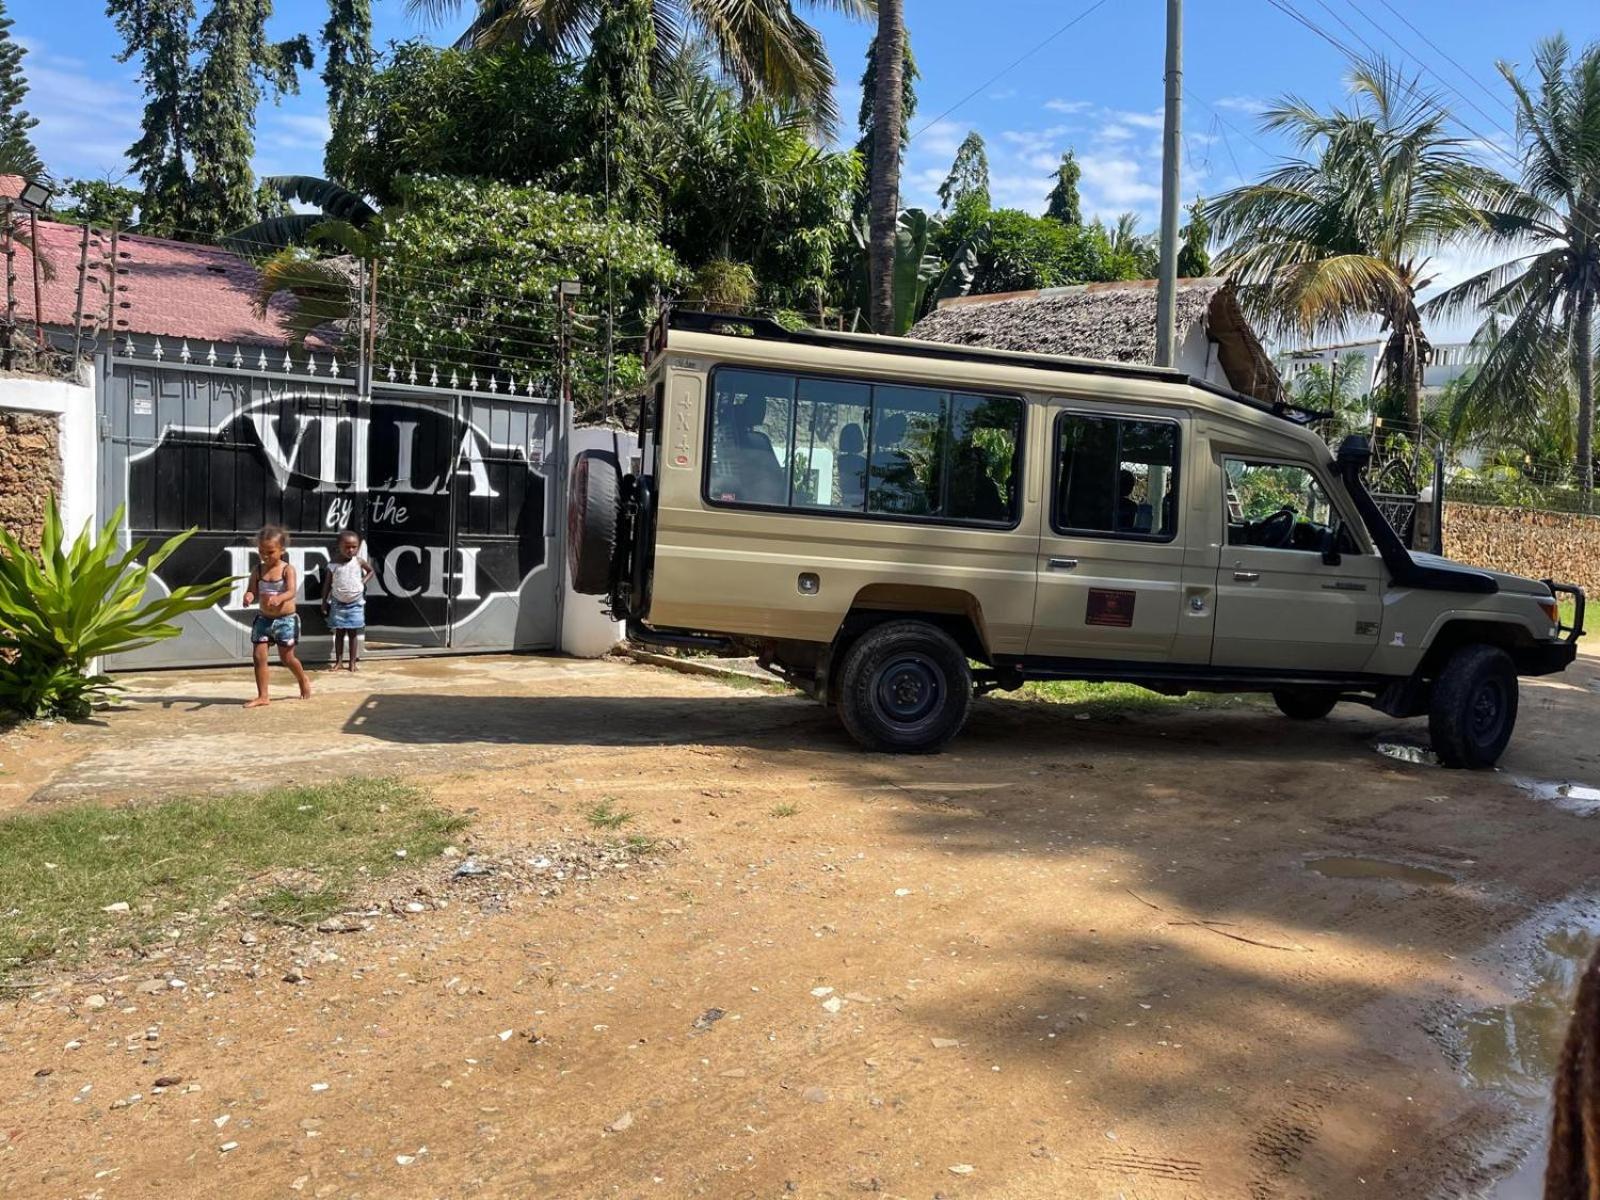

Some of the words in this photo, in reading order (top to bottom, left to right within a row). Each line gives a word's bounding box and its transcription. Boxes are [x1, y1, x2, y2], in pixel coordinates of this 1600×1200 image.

[243, 412, 500, 497] VILLA
[326, 497, 353, 528] by
[372, 495, 410, 525] the
